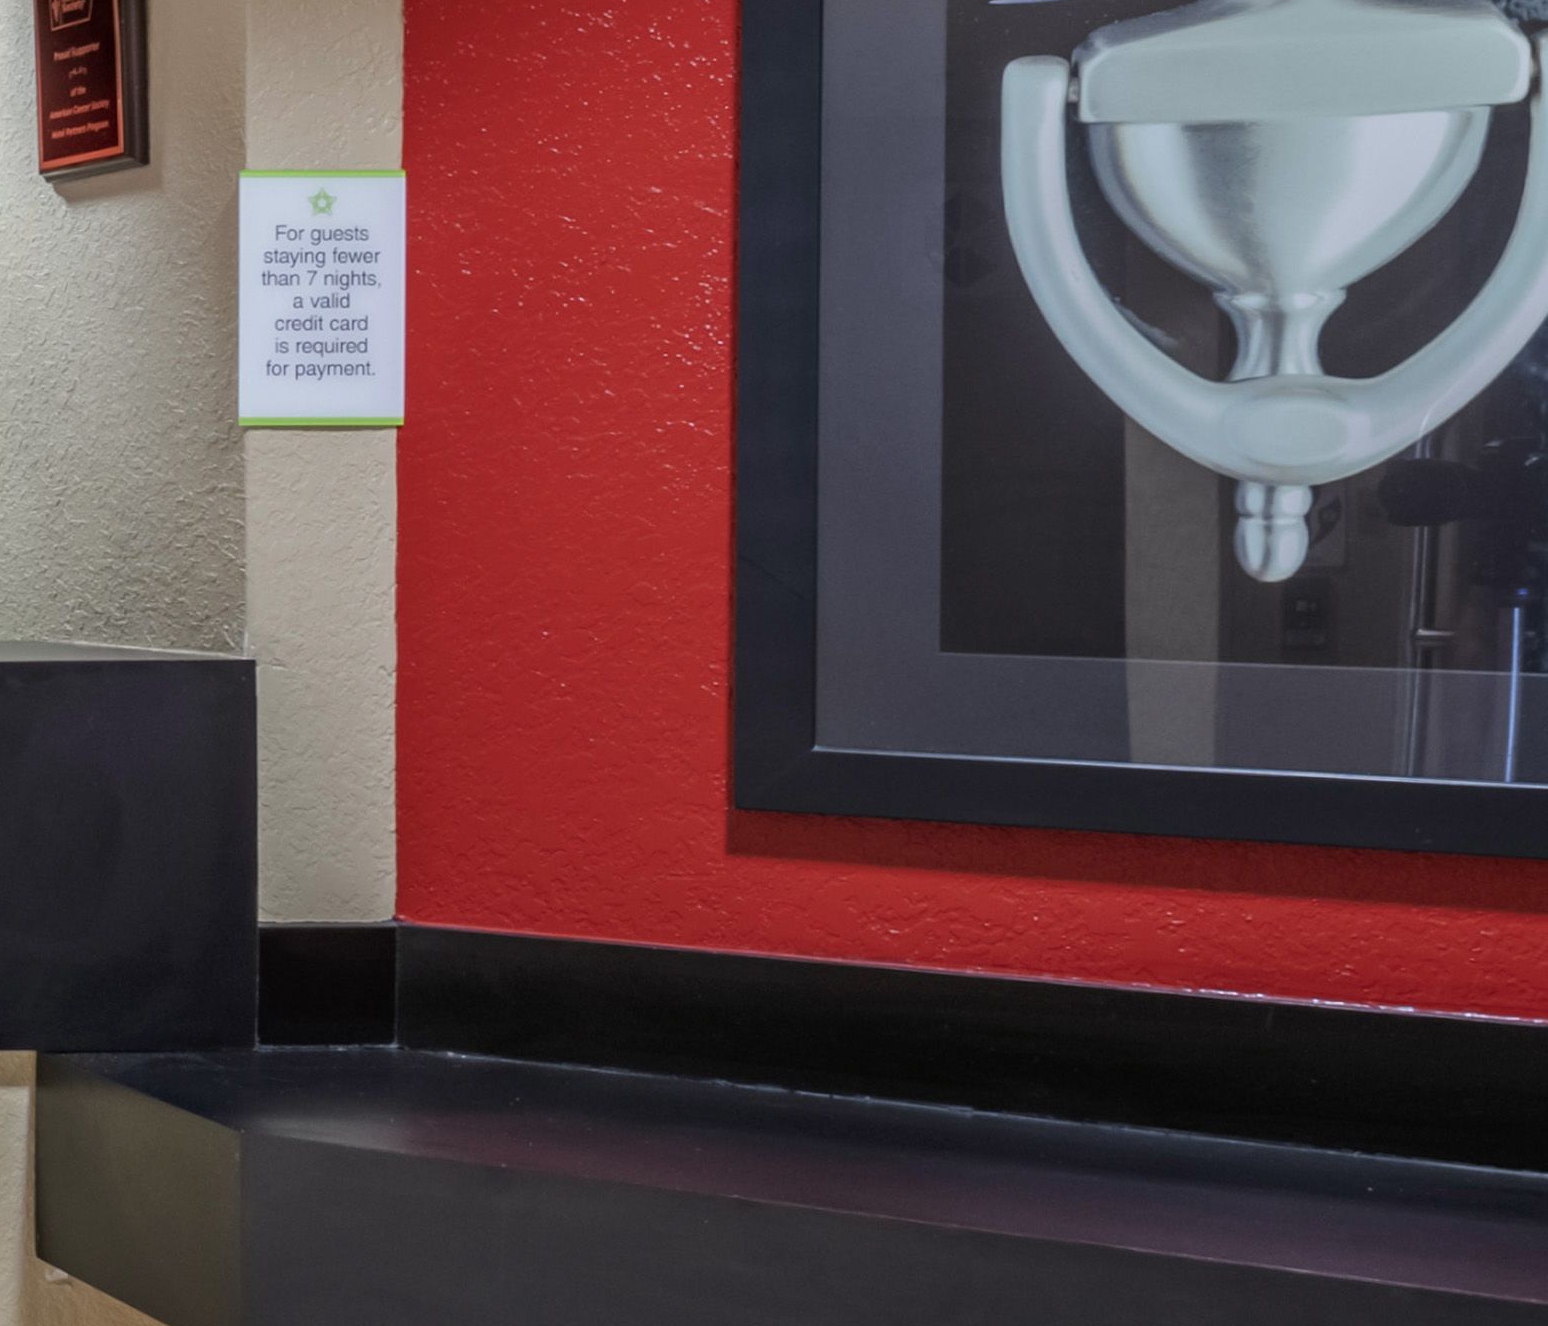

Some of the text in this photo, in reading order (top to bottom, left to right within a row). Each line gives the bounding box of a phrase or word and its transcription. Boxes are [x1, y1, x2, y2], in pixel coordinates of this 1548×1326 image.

[275, 225, 370, 245] For guests
[263, 247, 380, 268] staying fewer
[261, 270, 382, 290] than 7 nights,
[292, 293, 351, 309] a valid
[274, 315, 369, 331] credit card
[275, 337, 368, 357] is required
[266, 360, 376, 380] for payment.
